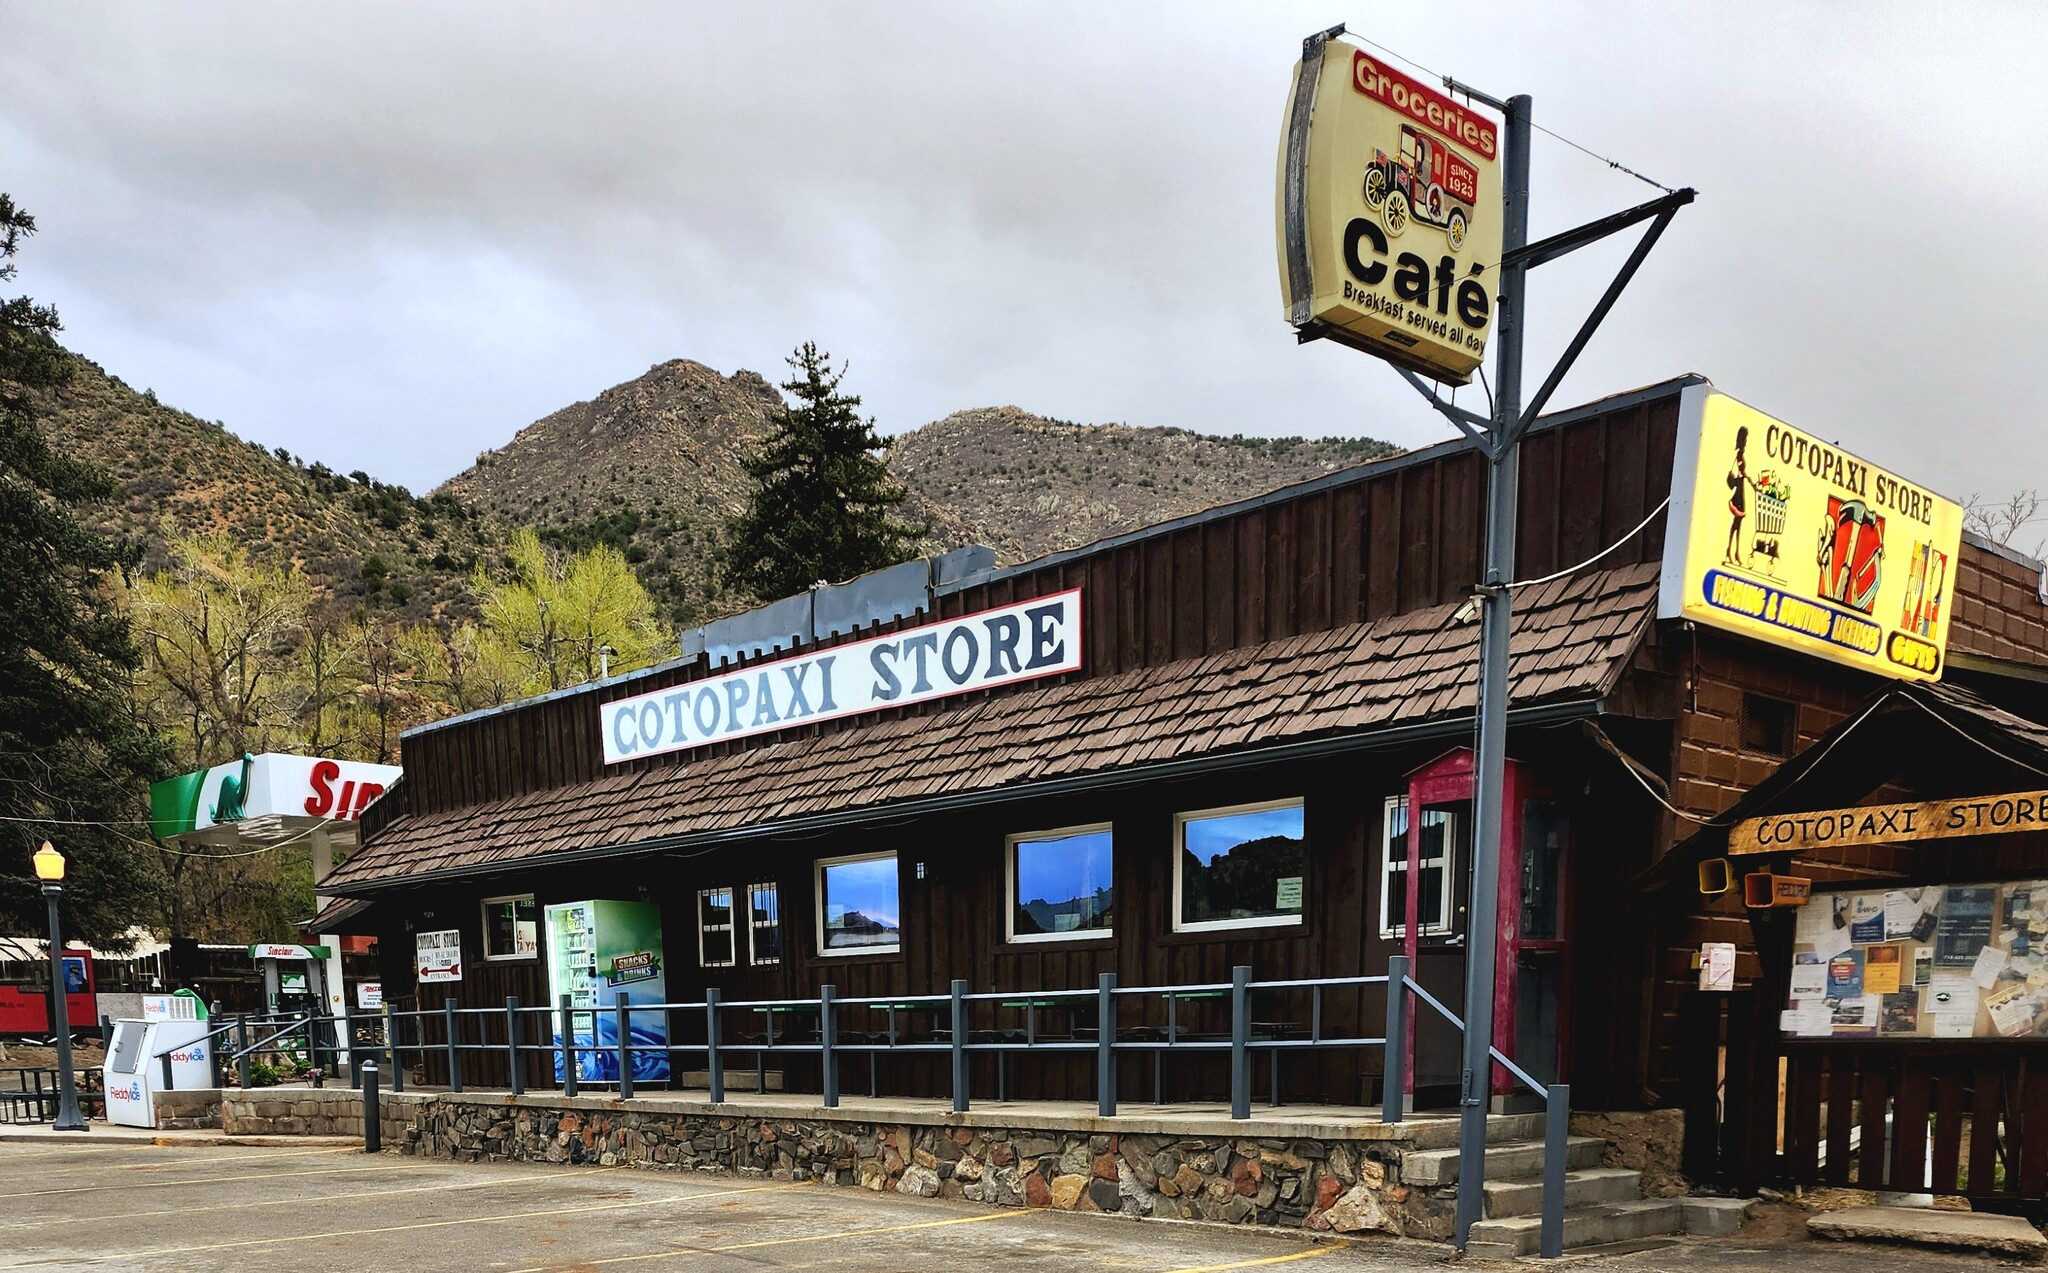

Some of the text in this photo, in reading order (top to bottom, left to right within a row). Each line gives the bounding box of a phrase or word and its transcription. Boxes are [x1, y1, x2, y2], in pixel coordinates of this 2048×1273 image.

[1356, 57, 1494, 154] Groceries
[1449, 176, 1473, 198] 1923
[1450, 164, 1473, 185] SINCE
[1343, 217, 1489, 329] Café
[1343, 280, 1486, 356] Breakfast served all day
[1766, 424, 1933, 526] COTOPAXI STORE
[1712, 575, 1881, 653] FISHING & HUNTING LICENSES
[1892, 635, 1937, 671] GIFTS
[613, 601, 1065, 755] COTOPAXI STORE
[1757, 795, 2048, 845] COTOPAXI STORE
[268, 946, 293, 955] Sinclair
[443, 932, 459, 948] STORE
[618, 955, 648, 969] SNACKS
[623, 967, 651, 980] DRINKS
[159, 1051, 204, 1063] eddyIce
